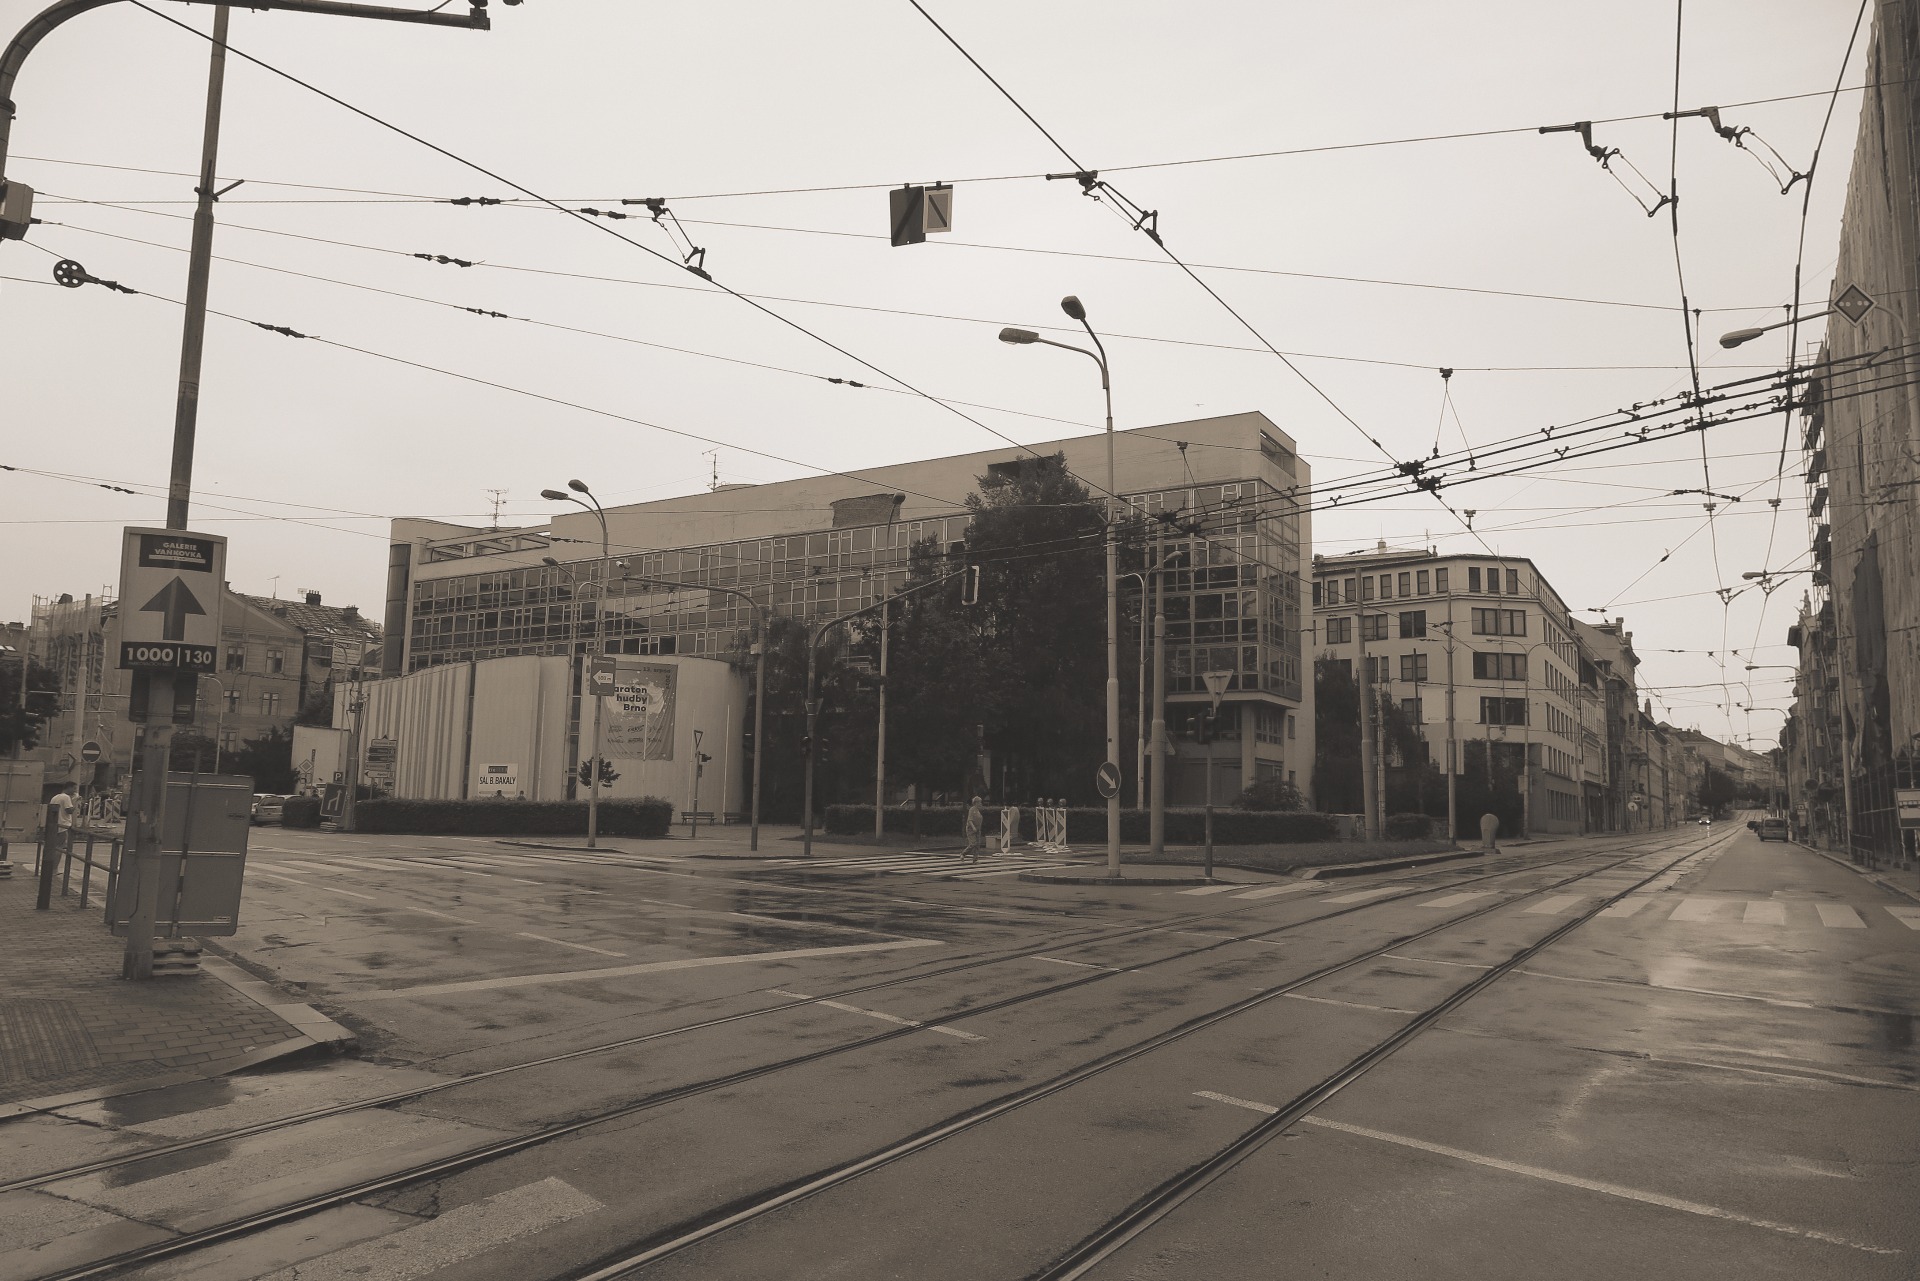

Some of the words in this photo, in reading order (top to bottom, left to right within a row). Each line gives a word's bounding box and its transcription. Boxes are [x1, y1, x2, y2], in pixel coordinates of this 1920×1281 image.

[163, 542, 197, 551] GALERIE
[155, 548, 202, 558] VAŇKOVKA
[127, 647, 174, 662] 1000
[184, 649, 212, 664] 130
[617, 694, 647, 704] hudby
[623, 704, 647, 712] Brno
[335, 772, 342, 781] P
